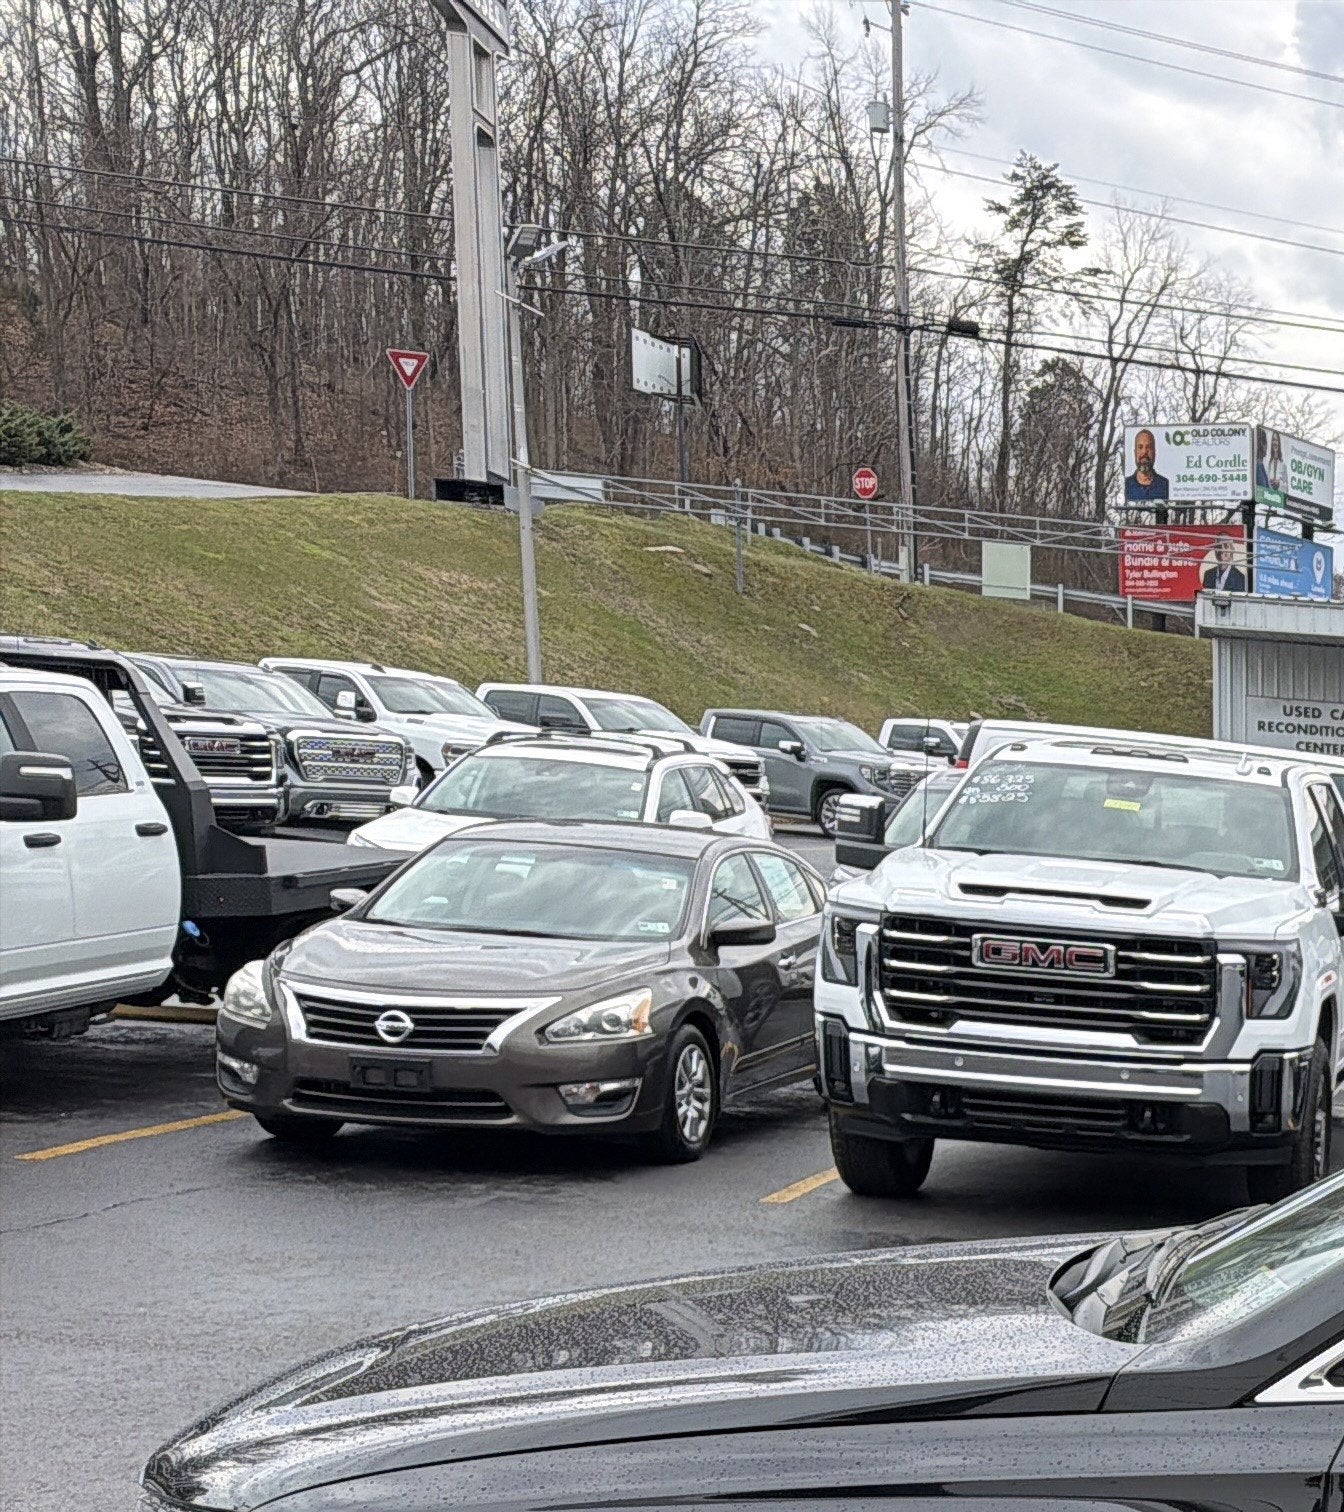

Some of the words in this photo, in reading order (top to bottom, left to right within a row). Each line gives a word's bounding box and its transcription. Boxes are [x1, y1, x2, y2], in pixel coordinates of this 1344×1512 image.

[1190, 428, 1209, 437] OLD
[1210, 427, 1247, 437] COLONY
[1191, 437, 1231, 446] REALTORS
[1185, 454, 1202, 468] Ed
[1205, 453, 1248, 468] Cordle
[1290, 458, 1325, 482] OB/GYN
[855, 477, 875, 489] STOP
[1175, 473, 1248, 482] 304-690-5448
[1290, 476, 1314, 495] CARE
[1282, 705, 1322, 719] USED
[982, 939, 1105, 972] GMC
